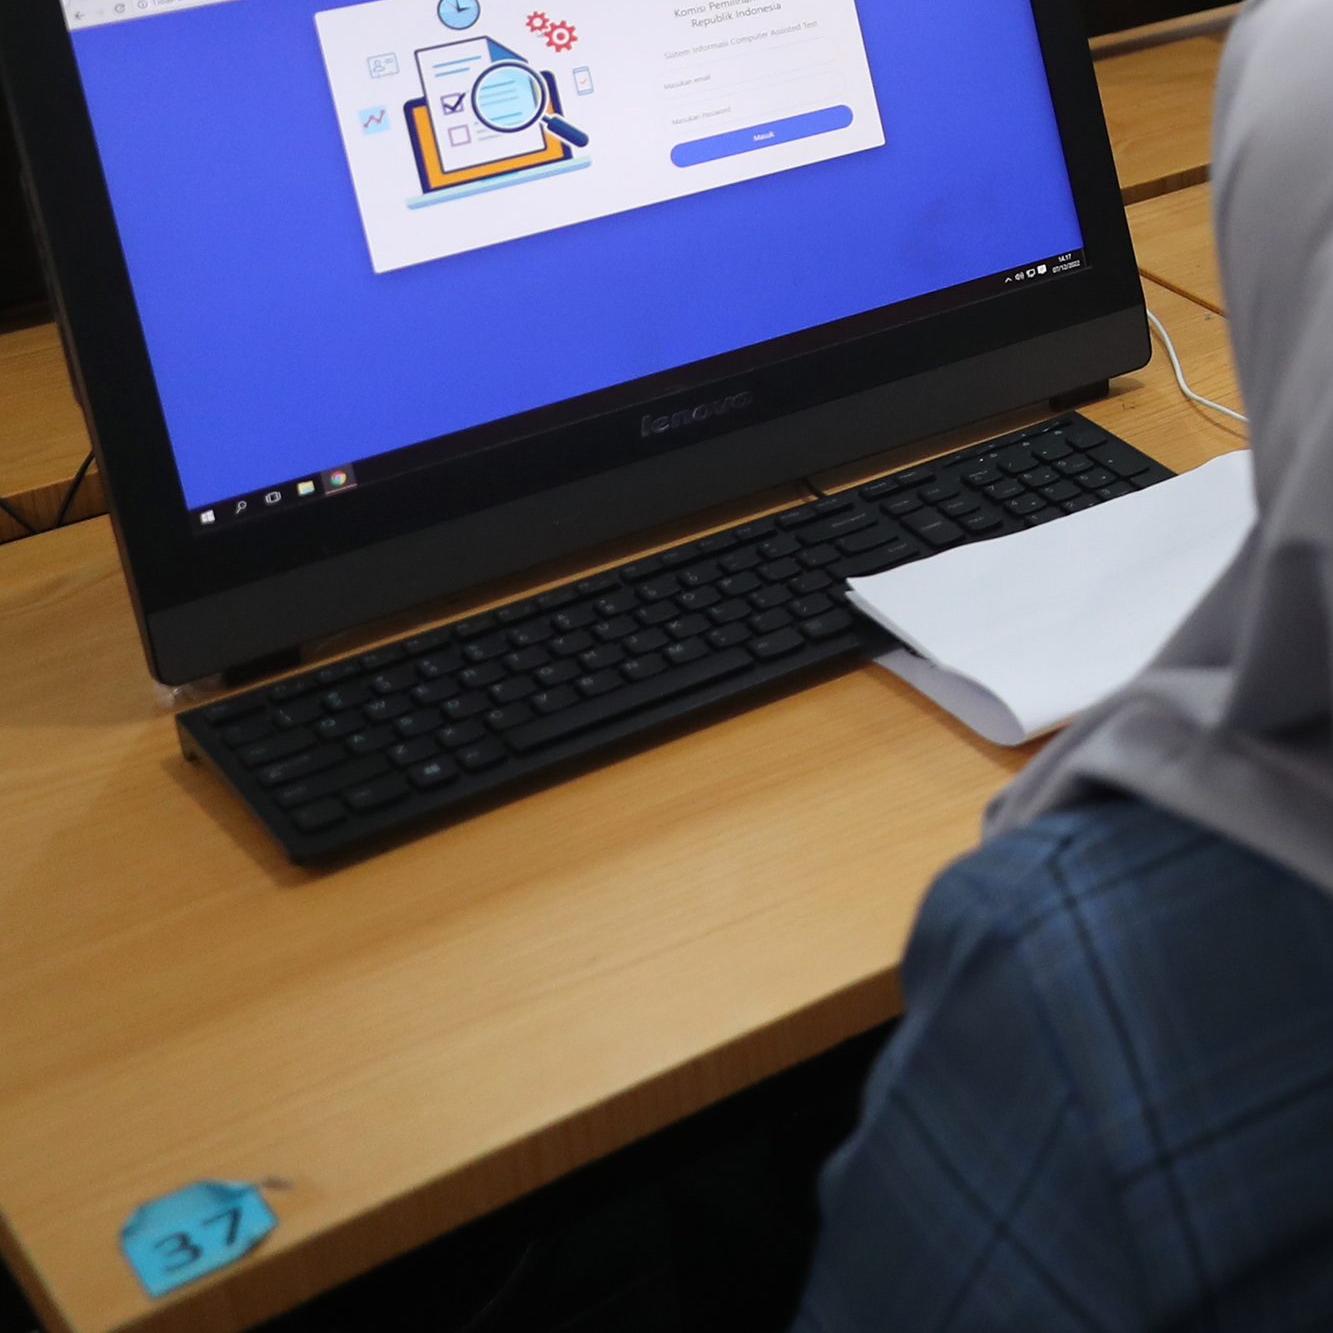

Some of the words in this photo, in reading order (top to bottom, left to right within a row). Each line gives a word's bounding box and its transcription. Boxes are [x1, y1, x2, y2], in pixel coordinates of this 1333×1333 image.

[674, 3, 706, 18] Komisi
[691, 12, 733, 28] Republik
[735, 2, 782, 19] Indonesia
[664, 48, 691, 60] Sistem
[692, 39, 729, 54] Informasi
[730, 31, 769, 47] Computer
[770, 23, 802, 37] Assisted
[803, 20, 818, 29] Test
[753, 130, 776, 142] Masuk
[641, 391, 753, 438] lenovo
[154, 1207, 243, 1273] 37
